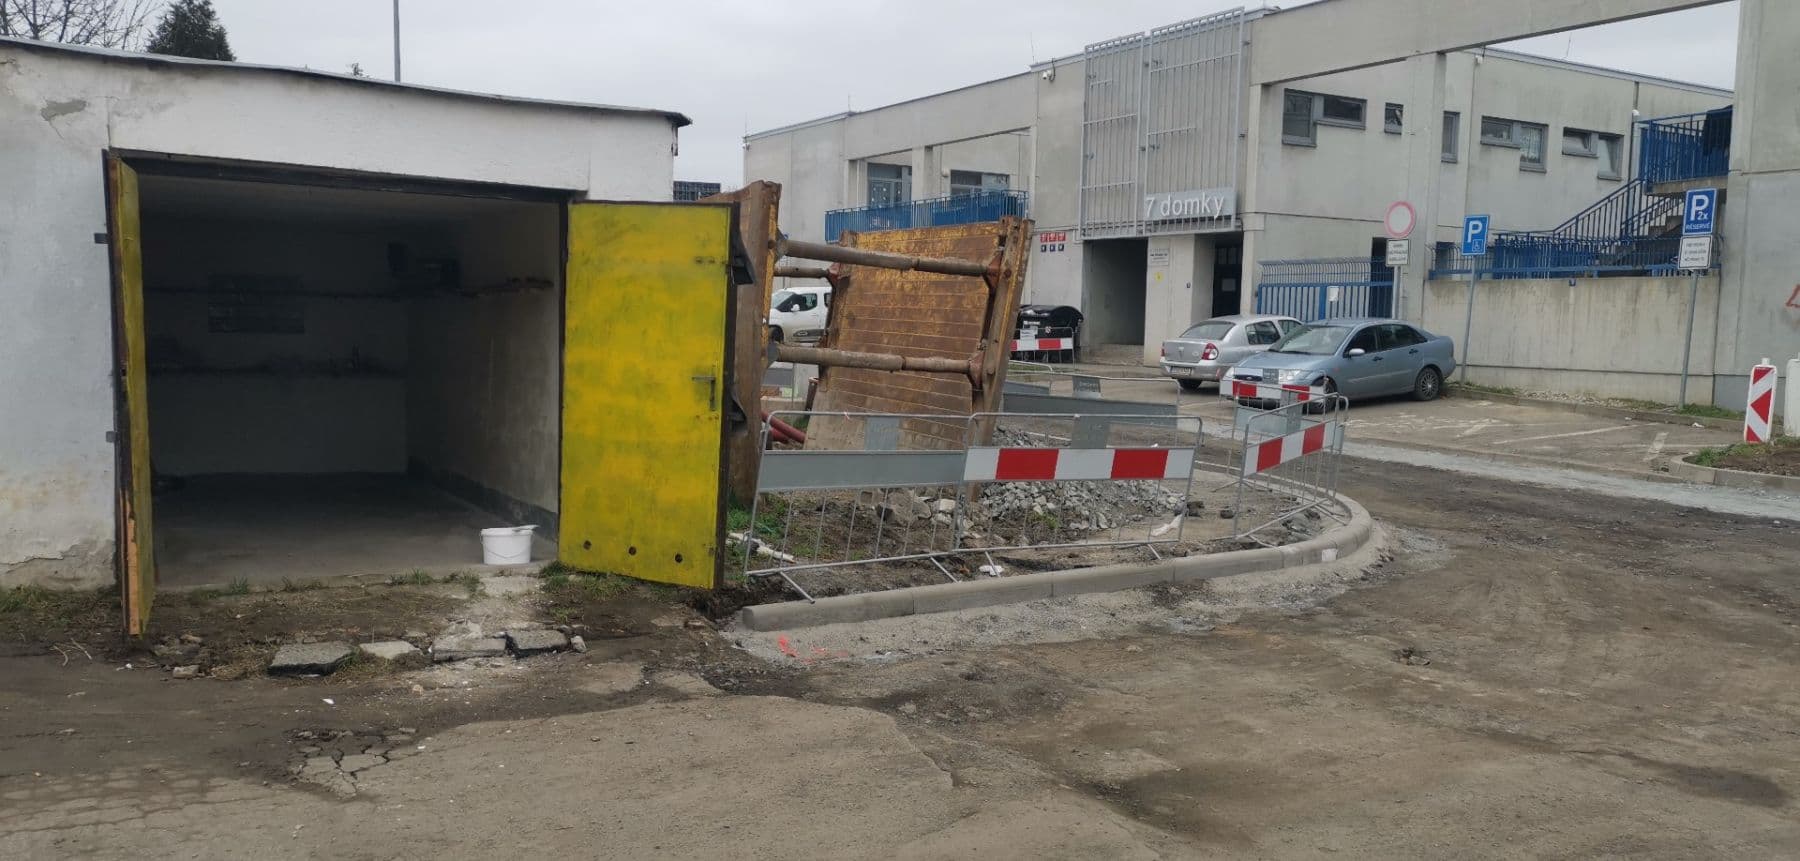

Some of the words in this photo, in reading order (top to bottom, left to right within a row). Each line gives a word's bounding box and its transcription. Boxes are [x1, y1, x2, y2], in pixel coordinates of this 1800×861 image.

[1145, 197, 1155, 218] 7
[1161, 192, 1225, 220] domky
[1690, 194, 1710, 221] P
[1697, 211, 1709, 221] 2x
[1467, 220, 1483, 243] P
